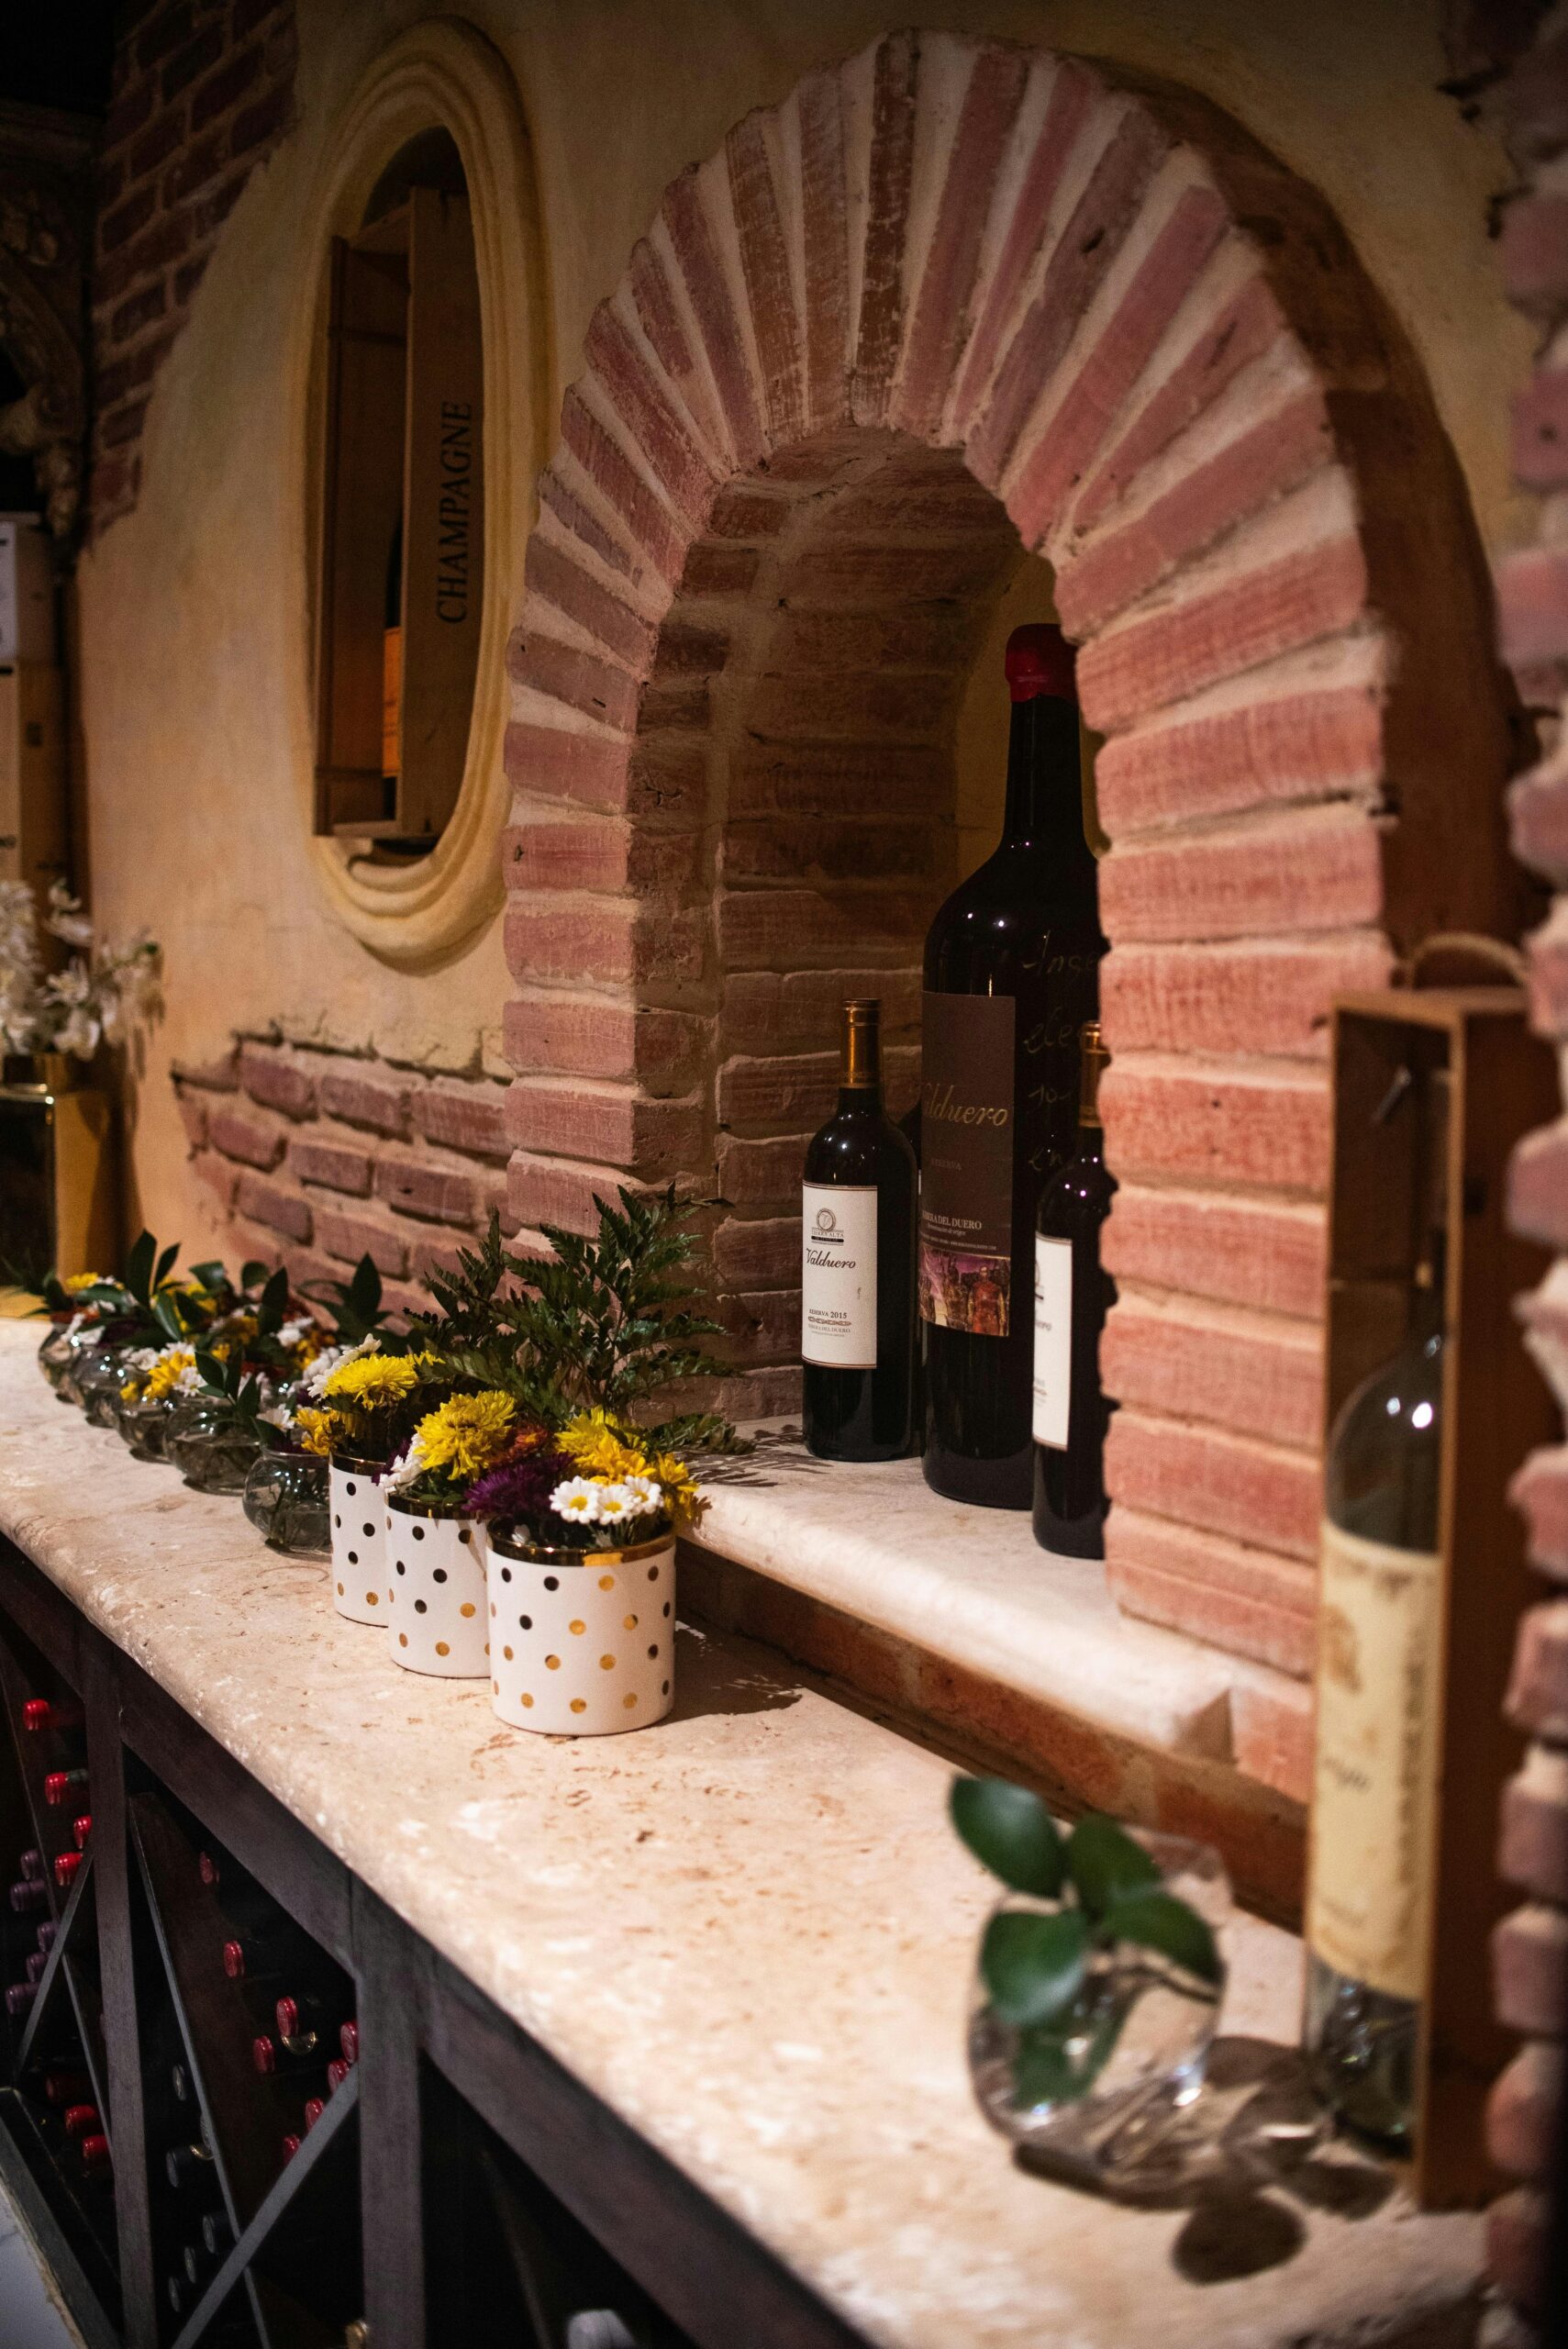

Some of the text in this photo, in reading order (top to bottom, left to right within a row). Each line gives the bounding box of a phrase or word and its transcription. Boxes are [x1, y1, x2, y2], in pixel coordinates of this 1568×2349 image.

[436, 400, 472, 624] CHAMPAGNE
[938, 1215, 951, 1227] DEL
[951, 1218, 983, 1230] DUERO
[806, 1247, 856, 1269] Valduero
